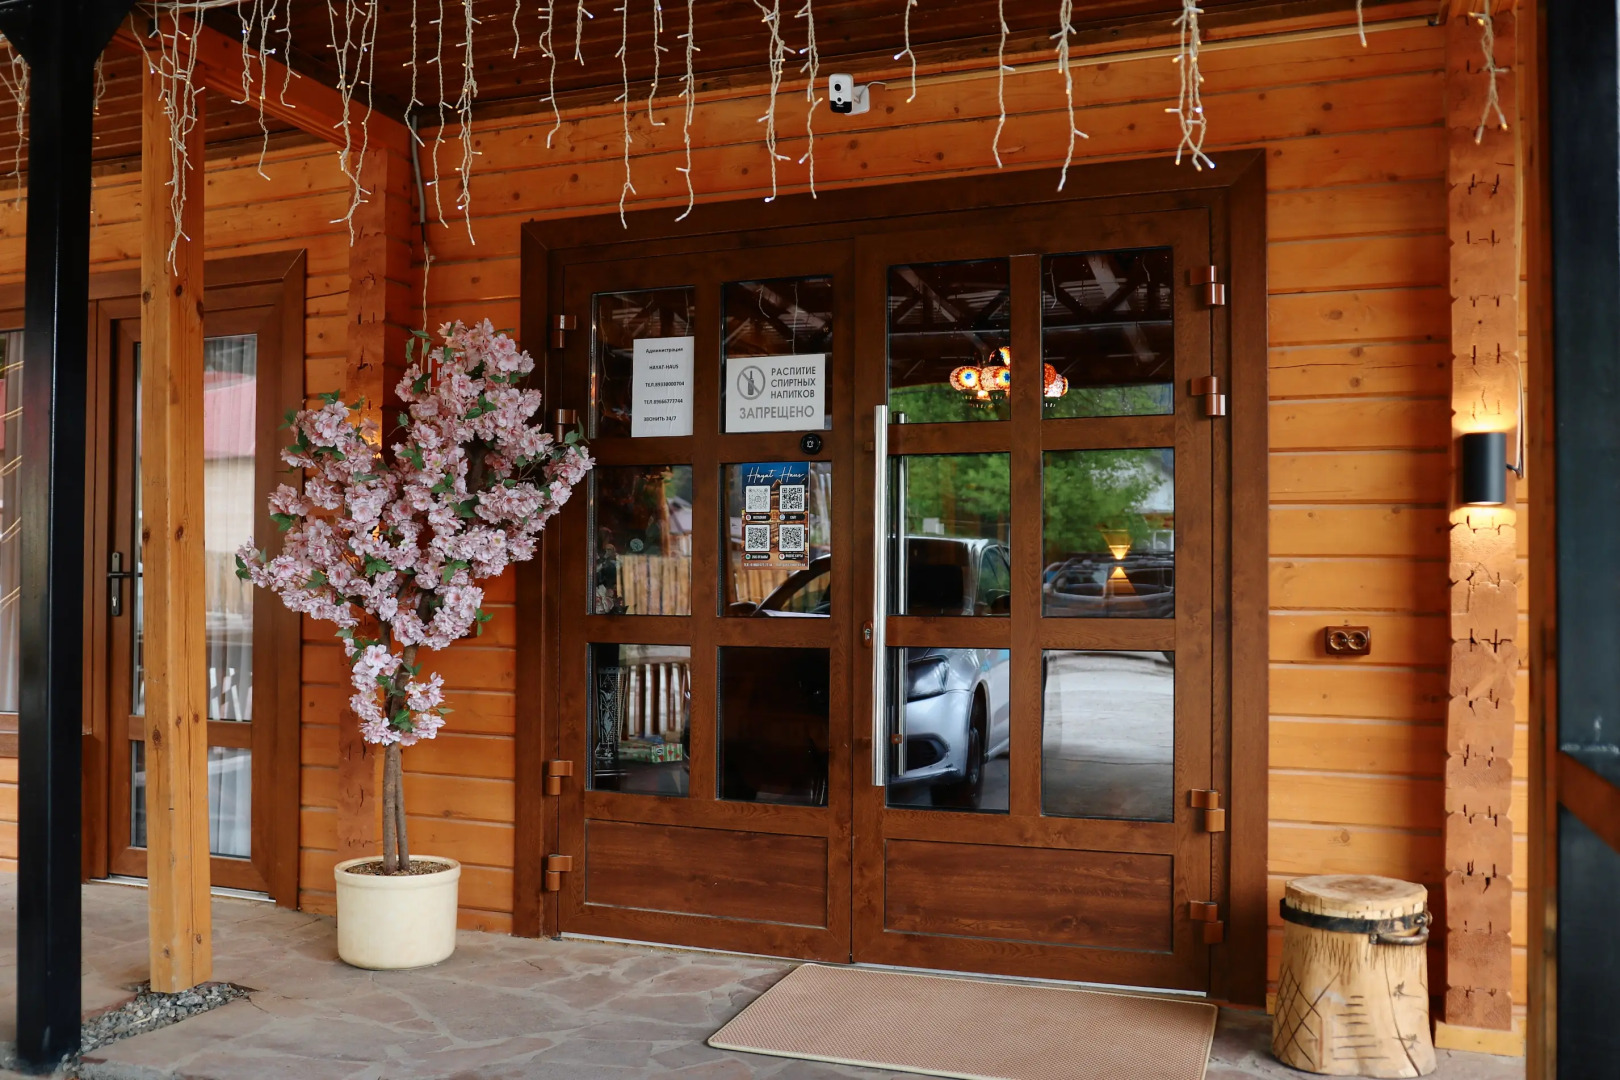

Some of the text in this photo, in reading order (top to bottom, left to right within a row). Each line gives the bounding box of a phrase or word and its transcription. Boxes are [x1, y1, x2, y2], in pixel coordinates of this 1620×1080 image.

[771, 366, 816, 376] РАСПИТИЕ
[770, 378, 816, 388] СПИРТНЫХ
[770, 389, 815, 399] НАПИТКОВ
[739, 405, 815, 420] ЗАПРЕЩЕНО
[747, 465, 805, 484] Hayat Haus
